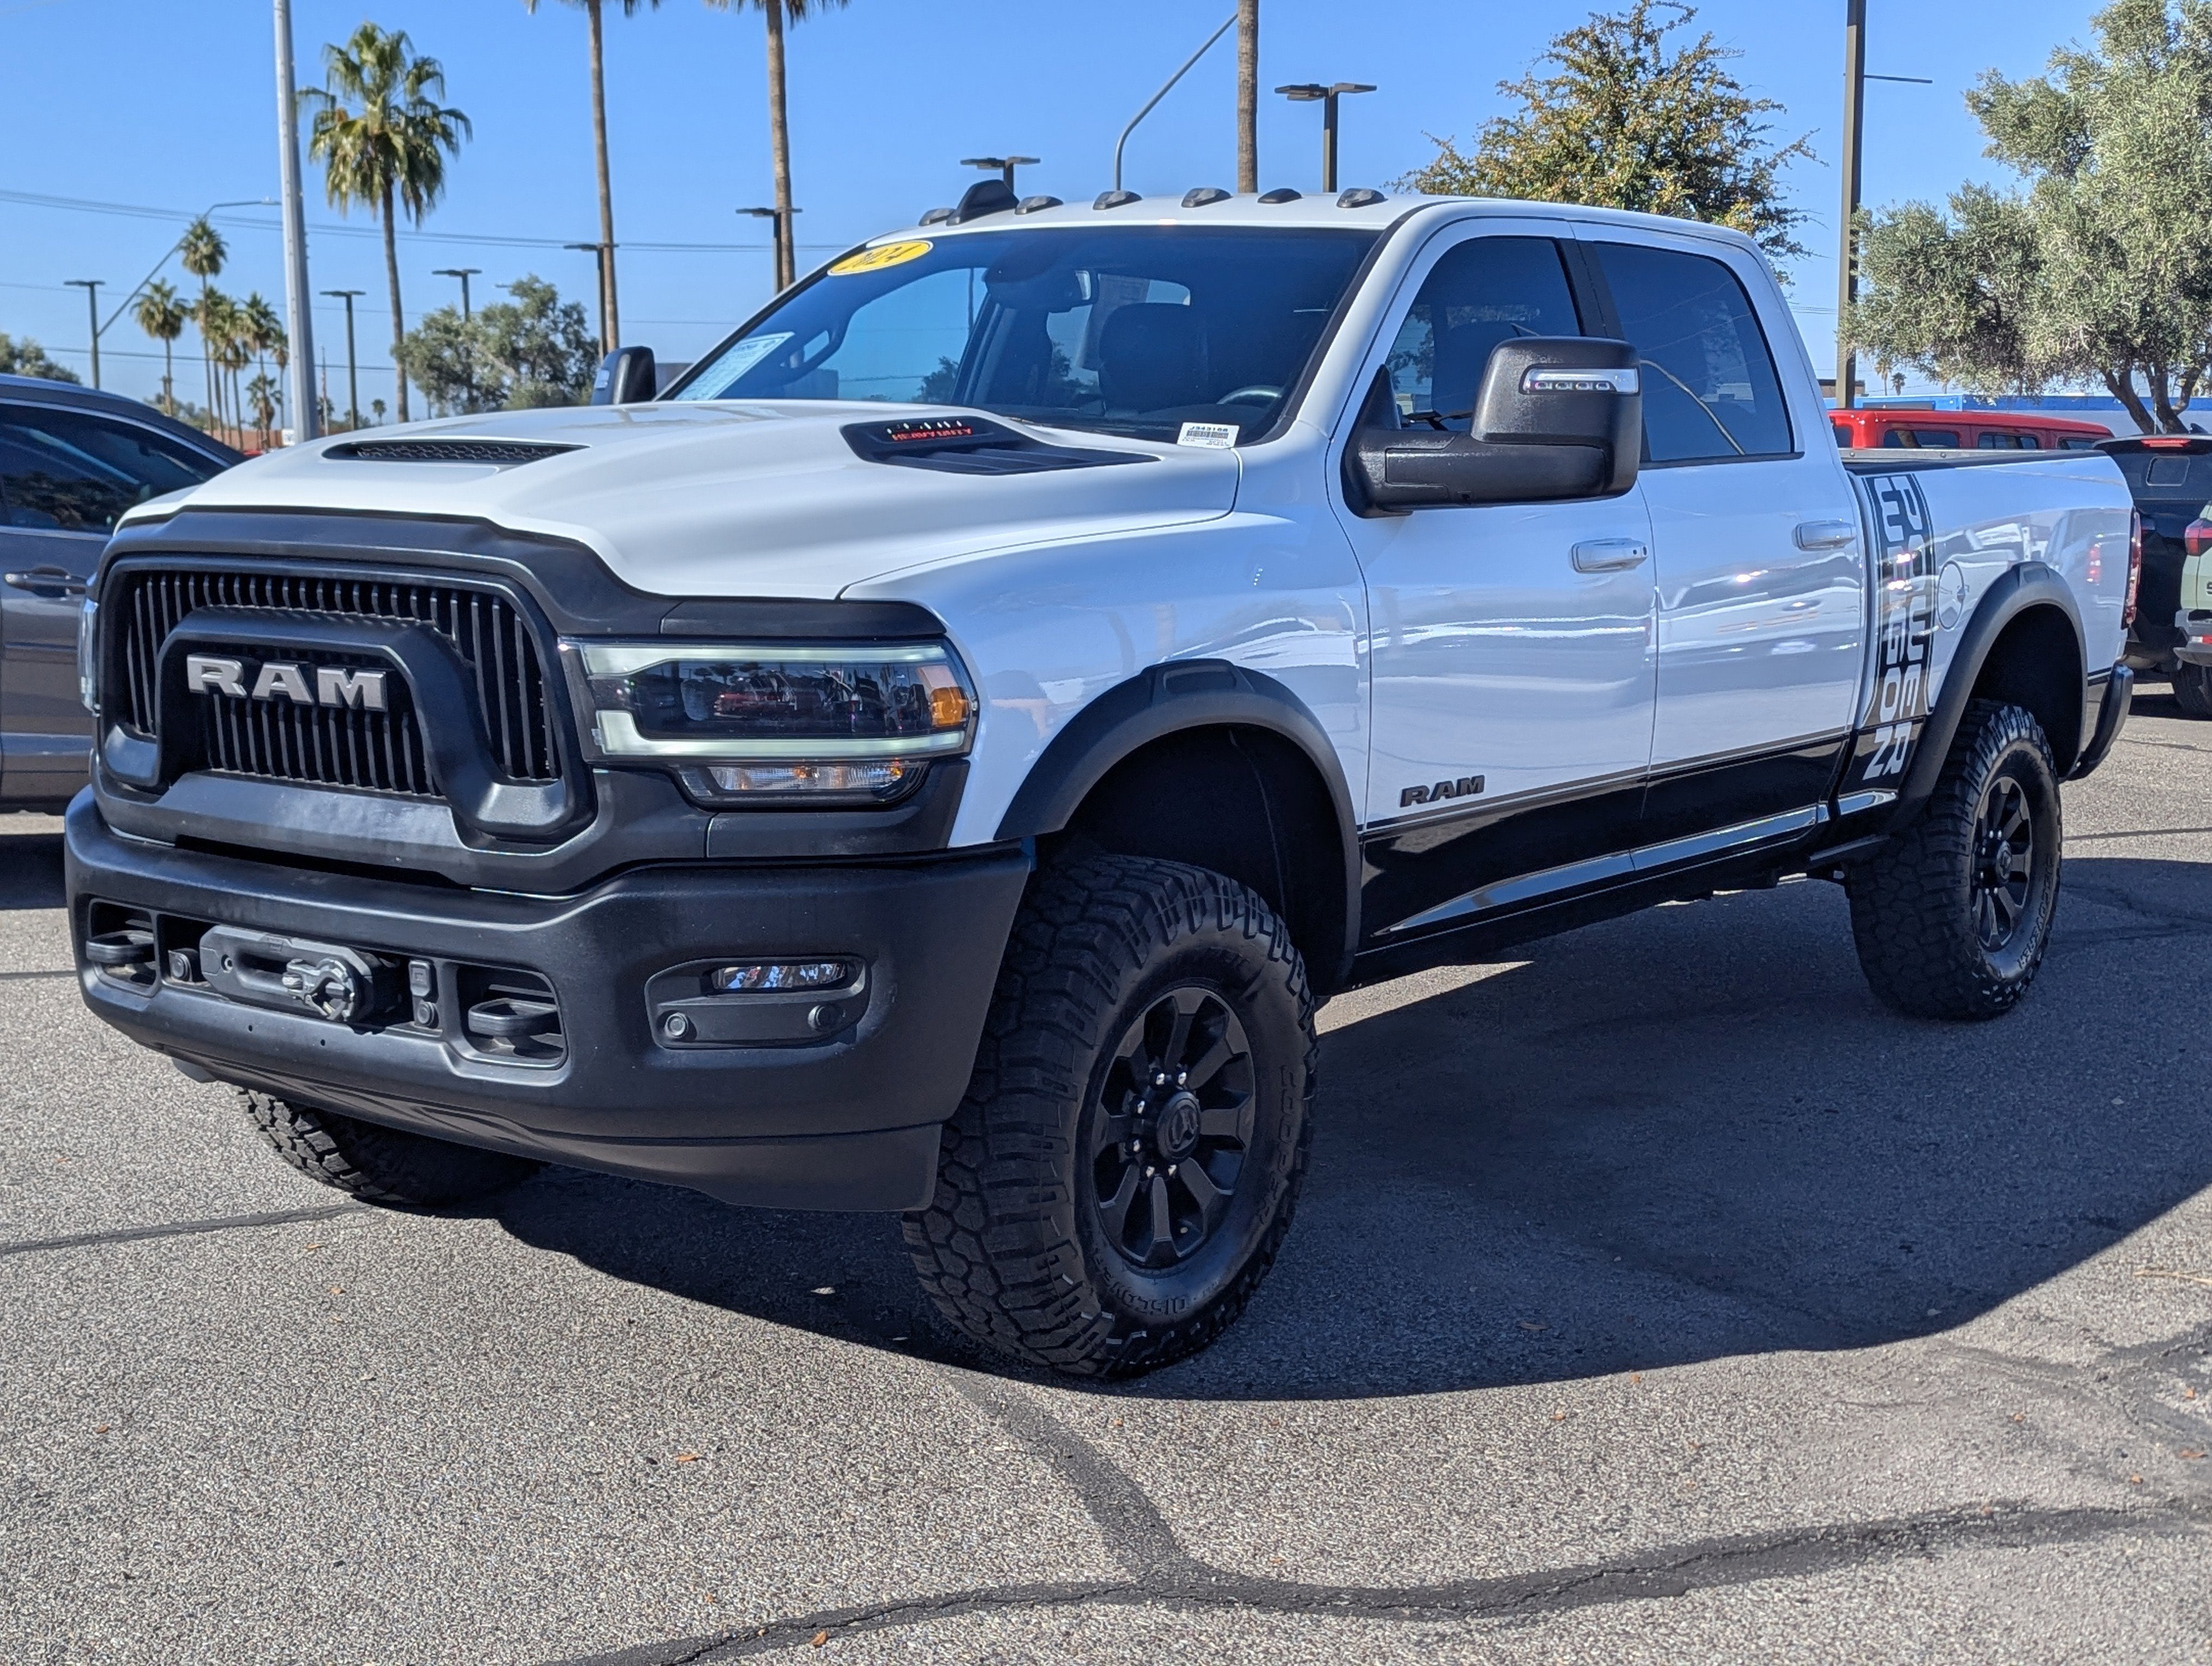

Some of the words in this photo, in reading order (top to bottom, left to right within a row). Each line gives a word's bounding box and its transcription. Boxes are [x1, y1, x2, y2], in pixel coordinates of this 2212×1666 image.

[187, 653, 387, 712] RAM
[1863, 478, 1905, 780] WAGON
[1882, 476, 1925, 774] POWER
[1400, 774, 1485, 808] RAM
